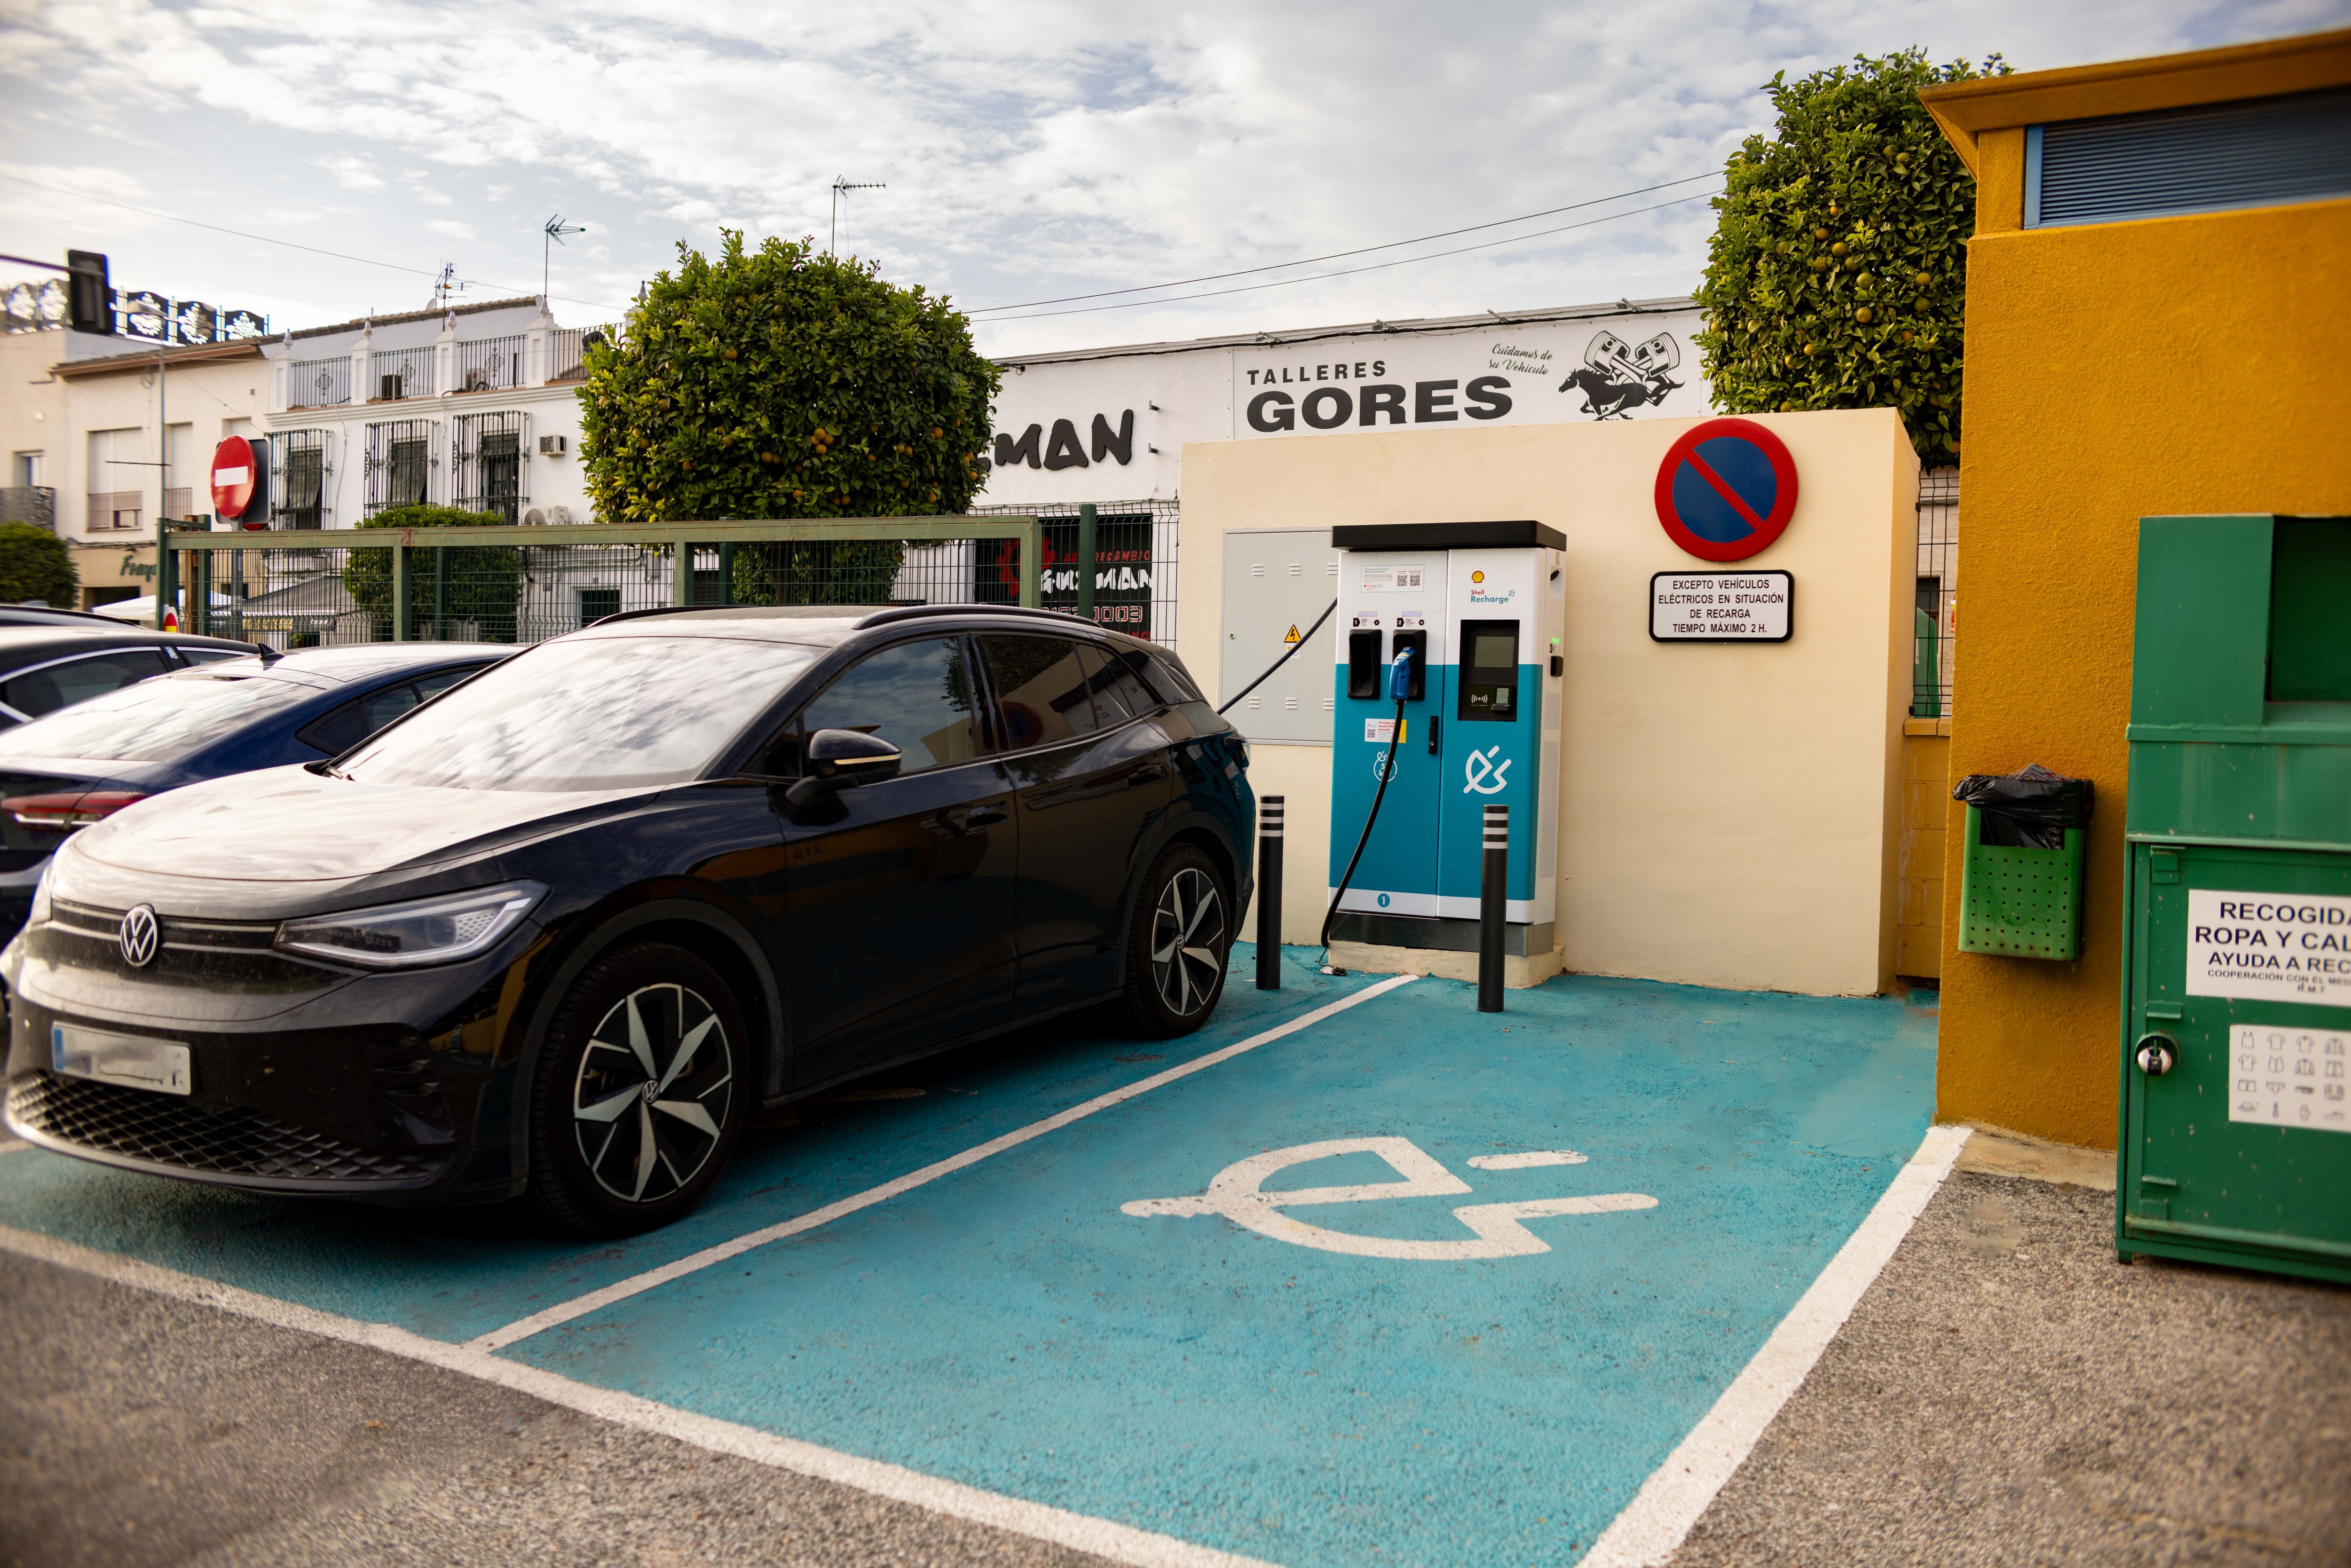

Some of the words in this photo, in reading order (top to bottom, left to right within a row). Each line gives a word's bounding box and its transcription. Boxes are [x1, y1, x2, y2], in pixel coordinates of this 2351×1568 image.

[1492, 343, 1538, 359] Cuidamos
[1540, 350, 1552, 360] de
[1247, 360, 1386, 385] TALLERES
[1247, 376, 1513, 433] GORES
[977, 409, 1134, 472] MAN
[1041, 567, 1152, 593] GUMAN
[1673, 580, 1713, 589] EXCEPTO
[1718, 578, 1769, 589] VEHÍCULOS
[1471, 595, 1509, 604] Recharge
[1659, 593, 1713, 604] ELÉCTRICOS
[1719, 594, 1730, 603] EN
[1735, 592, 1783, 603] SITUACIÓN
[1690, 609, 1702, 618] DE
[1707, 609, 1751, 618] RECARGA
[1673, 624, 1705, 632] TIEMPO
[1711, 622, 1746, 632] MÁXIMO
[1751, 624, 1756, 632] 2
[1759, 624, 1767, 632] H.
[1381, 896, 1385, 905] 1
[2220, 902, 2351, 926] RECOGID
[2195, 926, 2268, 947] ROPA
[2276, 930, 2292, 948] Y
[2208, 952, 2280, 969] AYUDA
[2286, 956, 2300, 970] A
[2208, 969, 2283, 981] COOPERACIÓN
